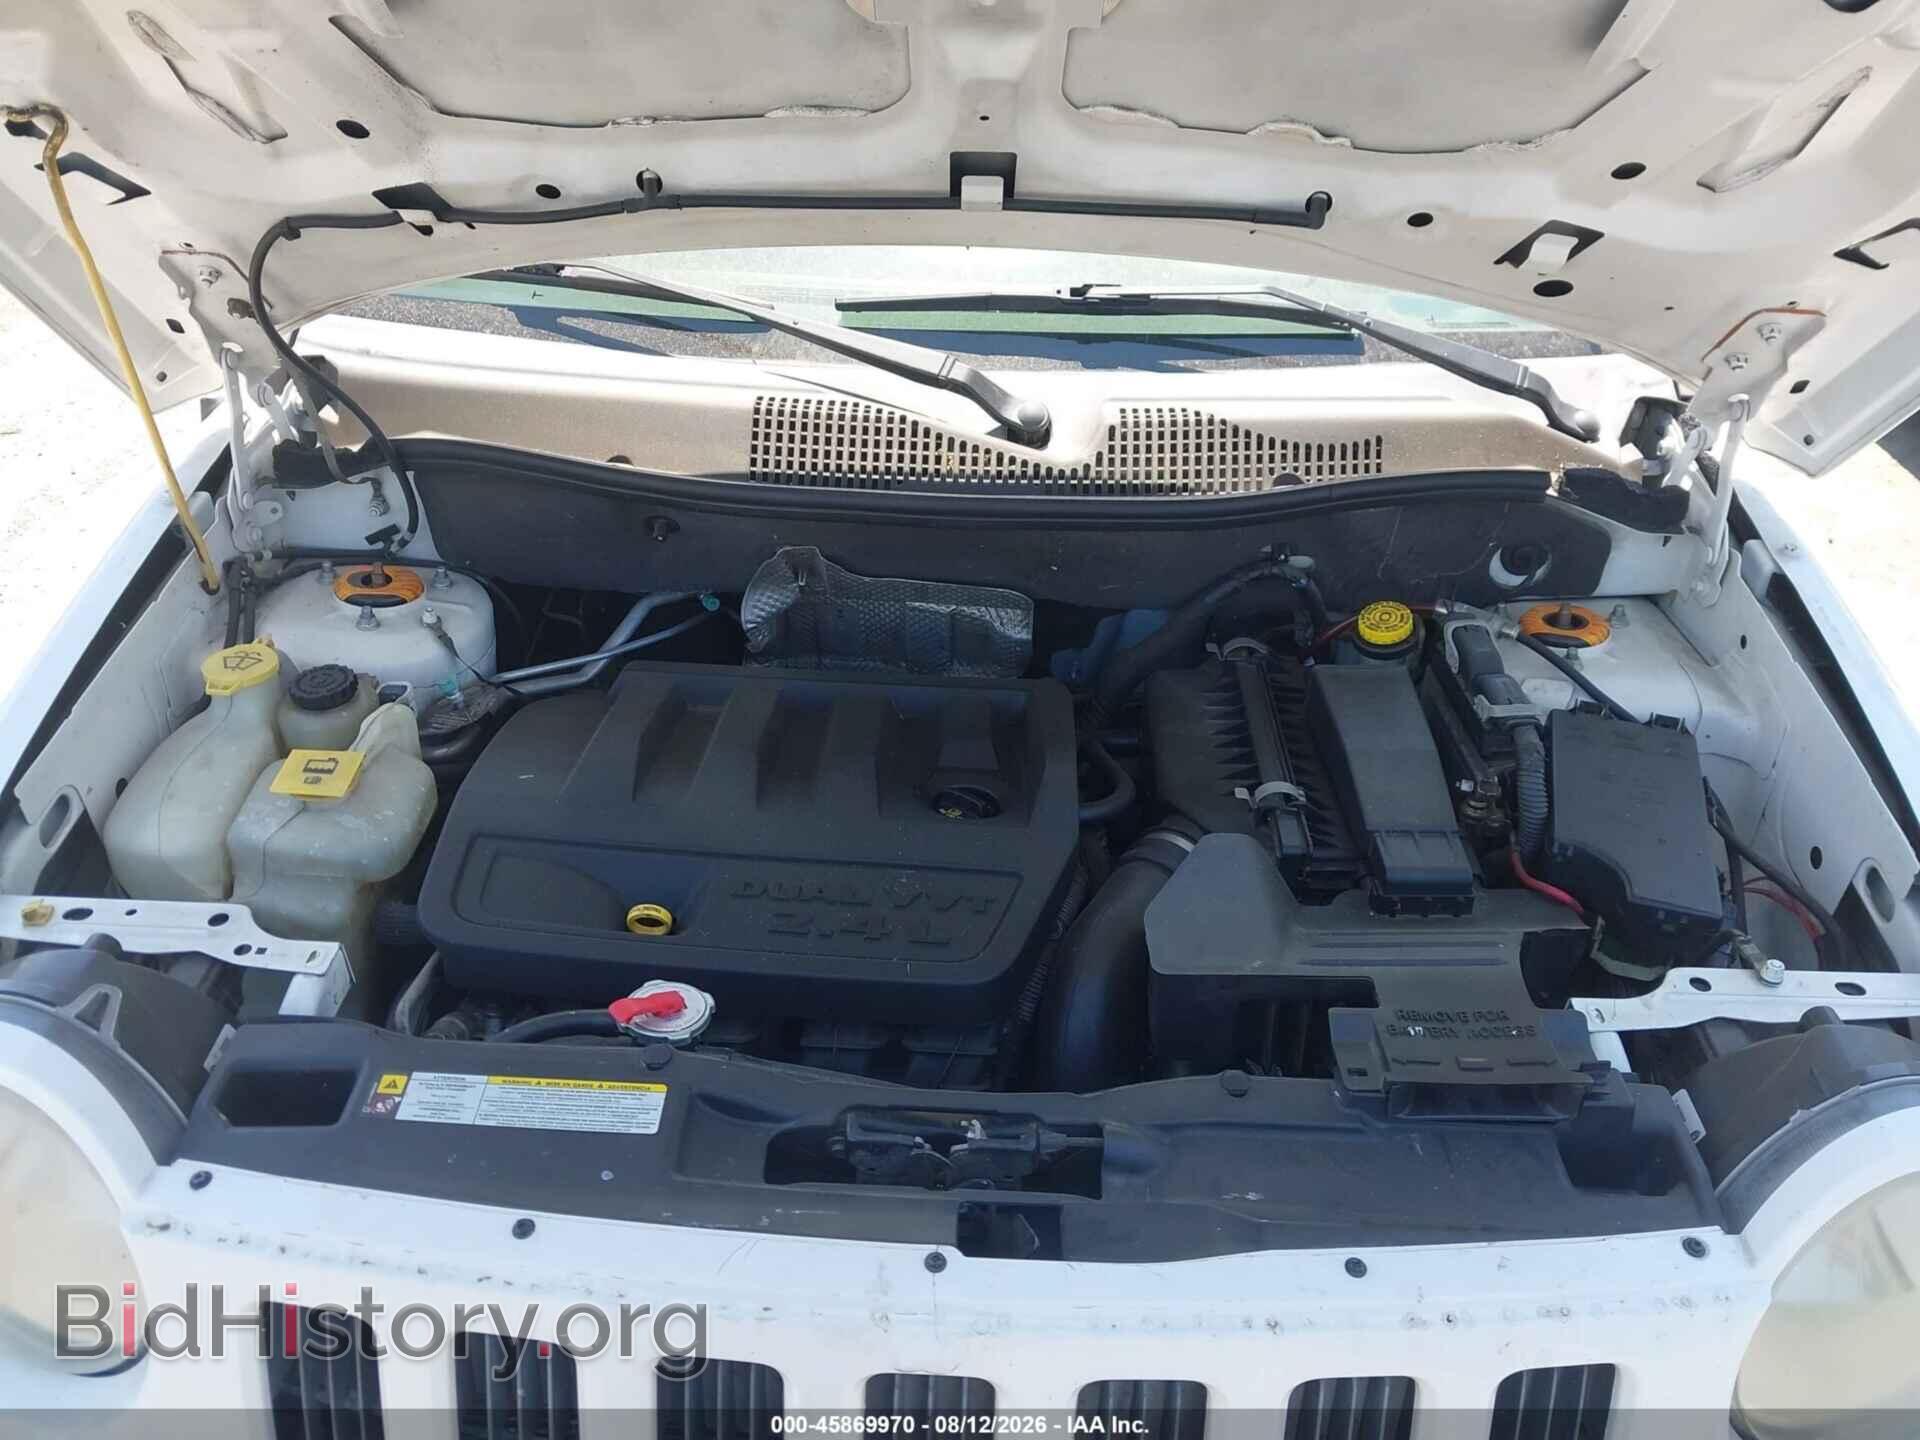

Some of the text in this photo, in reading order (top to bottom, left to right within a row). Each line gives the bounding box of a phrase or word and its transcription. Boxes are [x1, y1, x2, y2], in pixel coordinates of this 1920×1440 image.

[729, 876, 873, 907] DUAL
[1394, 1009, 1510, 1024] REMOVE FOR
[1386, 1023, 1537, 1039] BATTERY ACCESS
